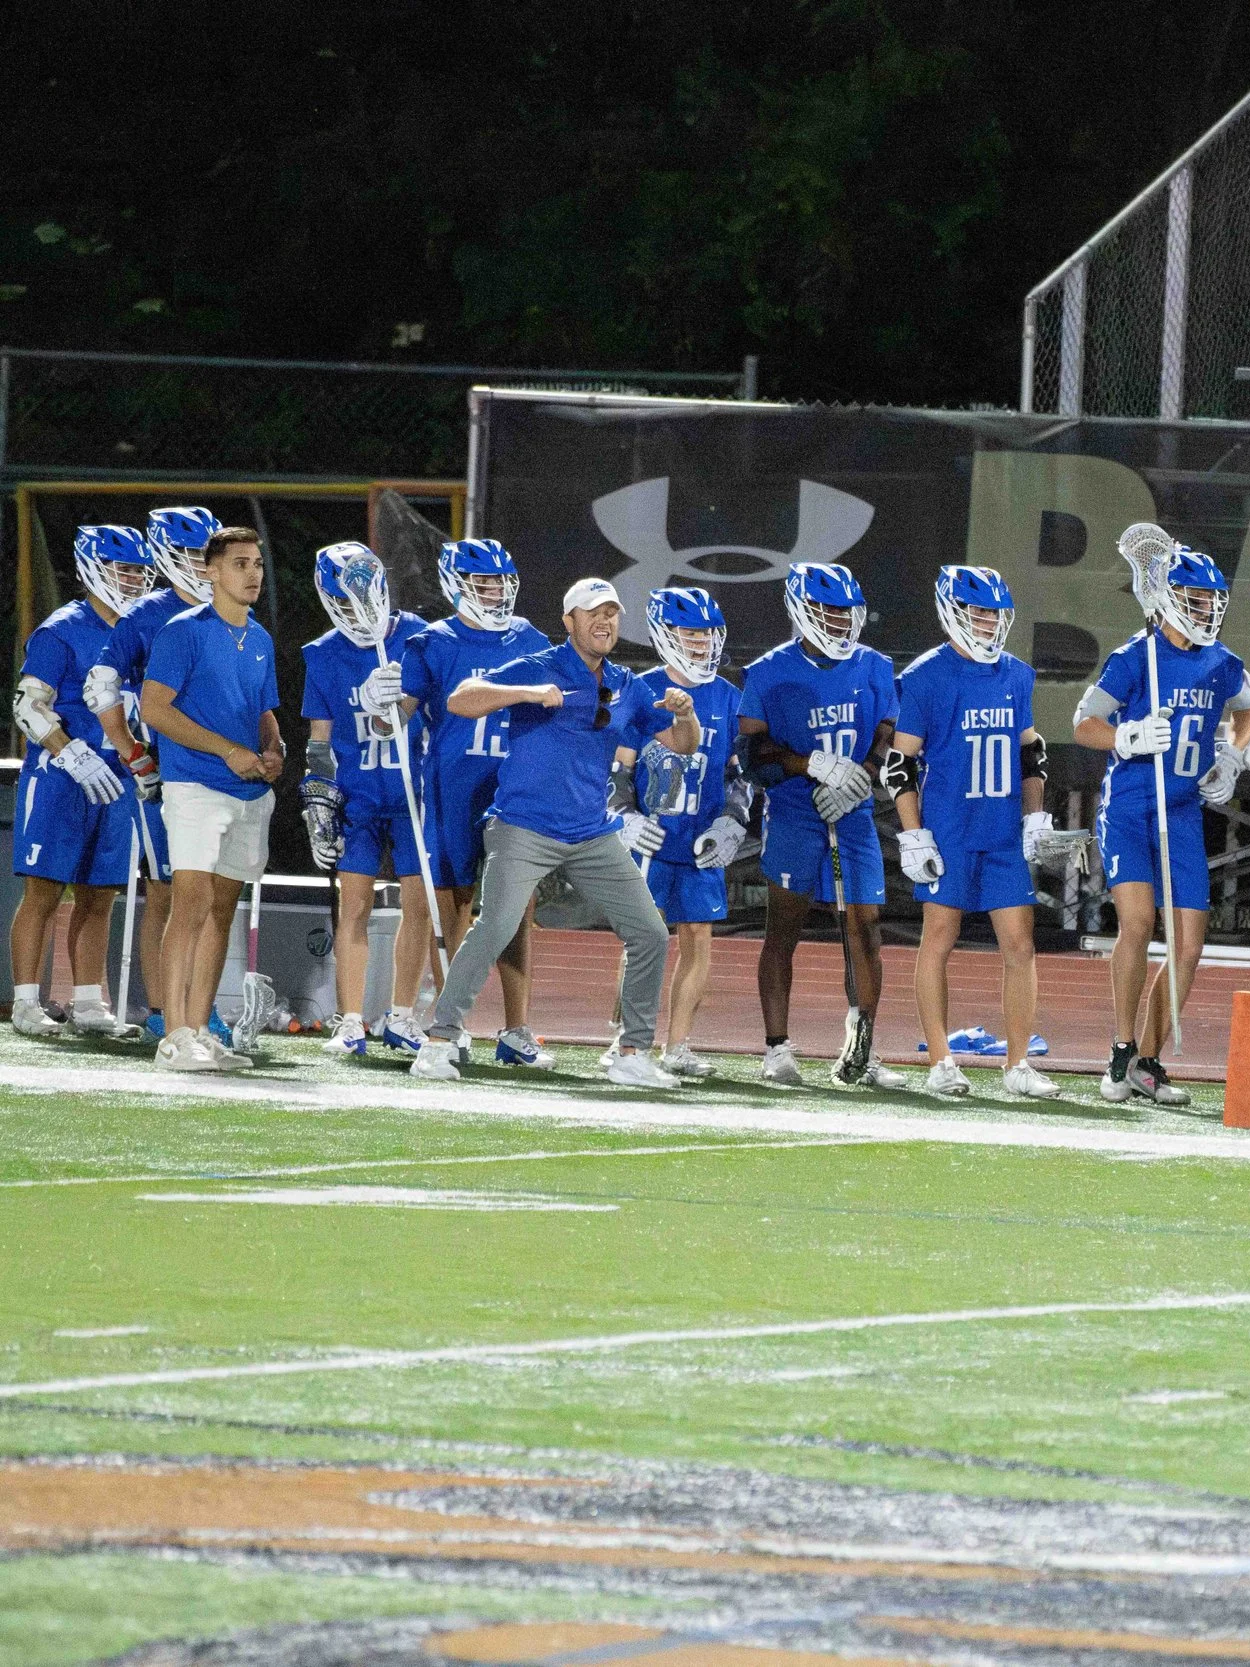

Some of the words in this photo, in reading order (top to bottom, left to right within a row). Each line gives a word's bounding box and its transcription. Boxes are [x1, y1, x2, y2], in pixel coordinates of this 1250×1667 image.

[965, 734, 1012, 798] 10
[1173, 714, 1204, 777] 6
[25, 843, 42, 866] J
[1109, 854, 1120, 879] J
